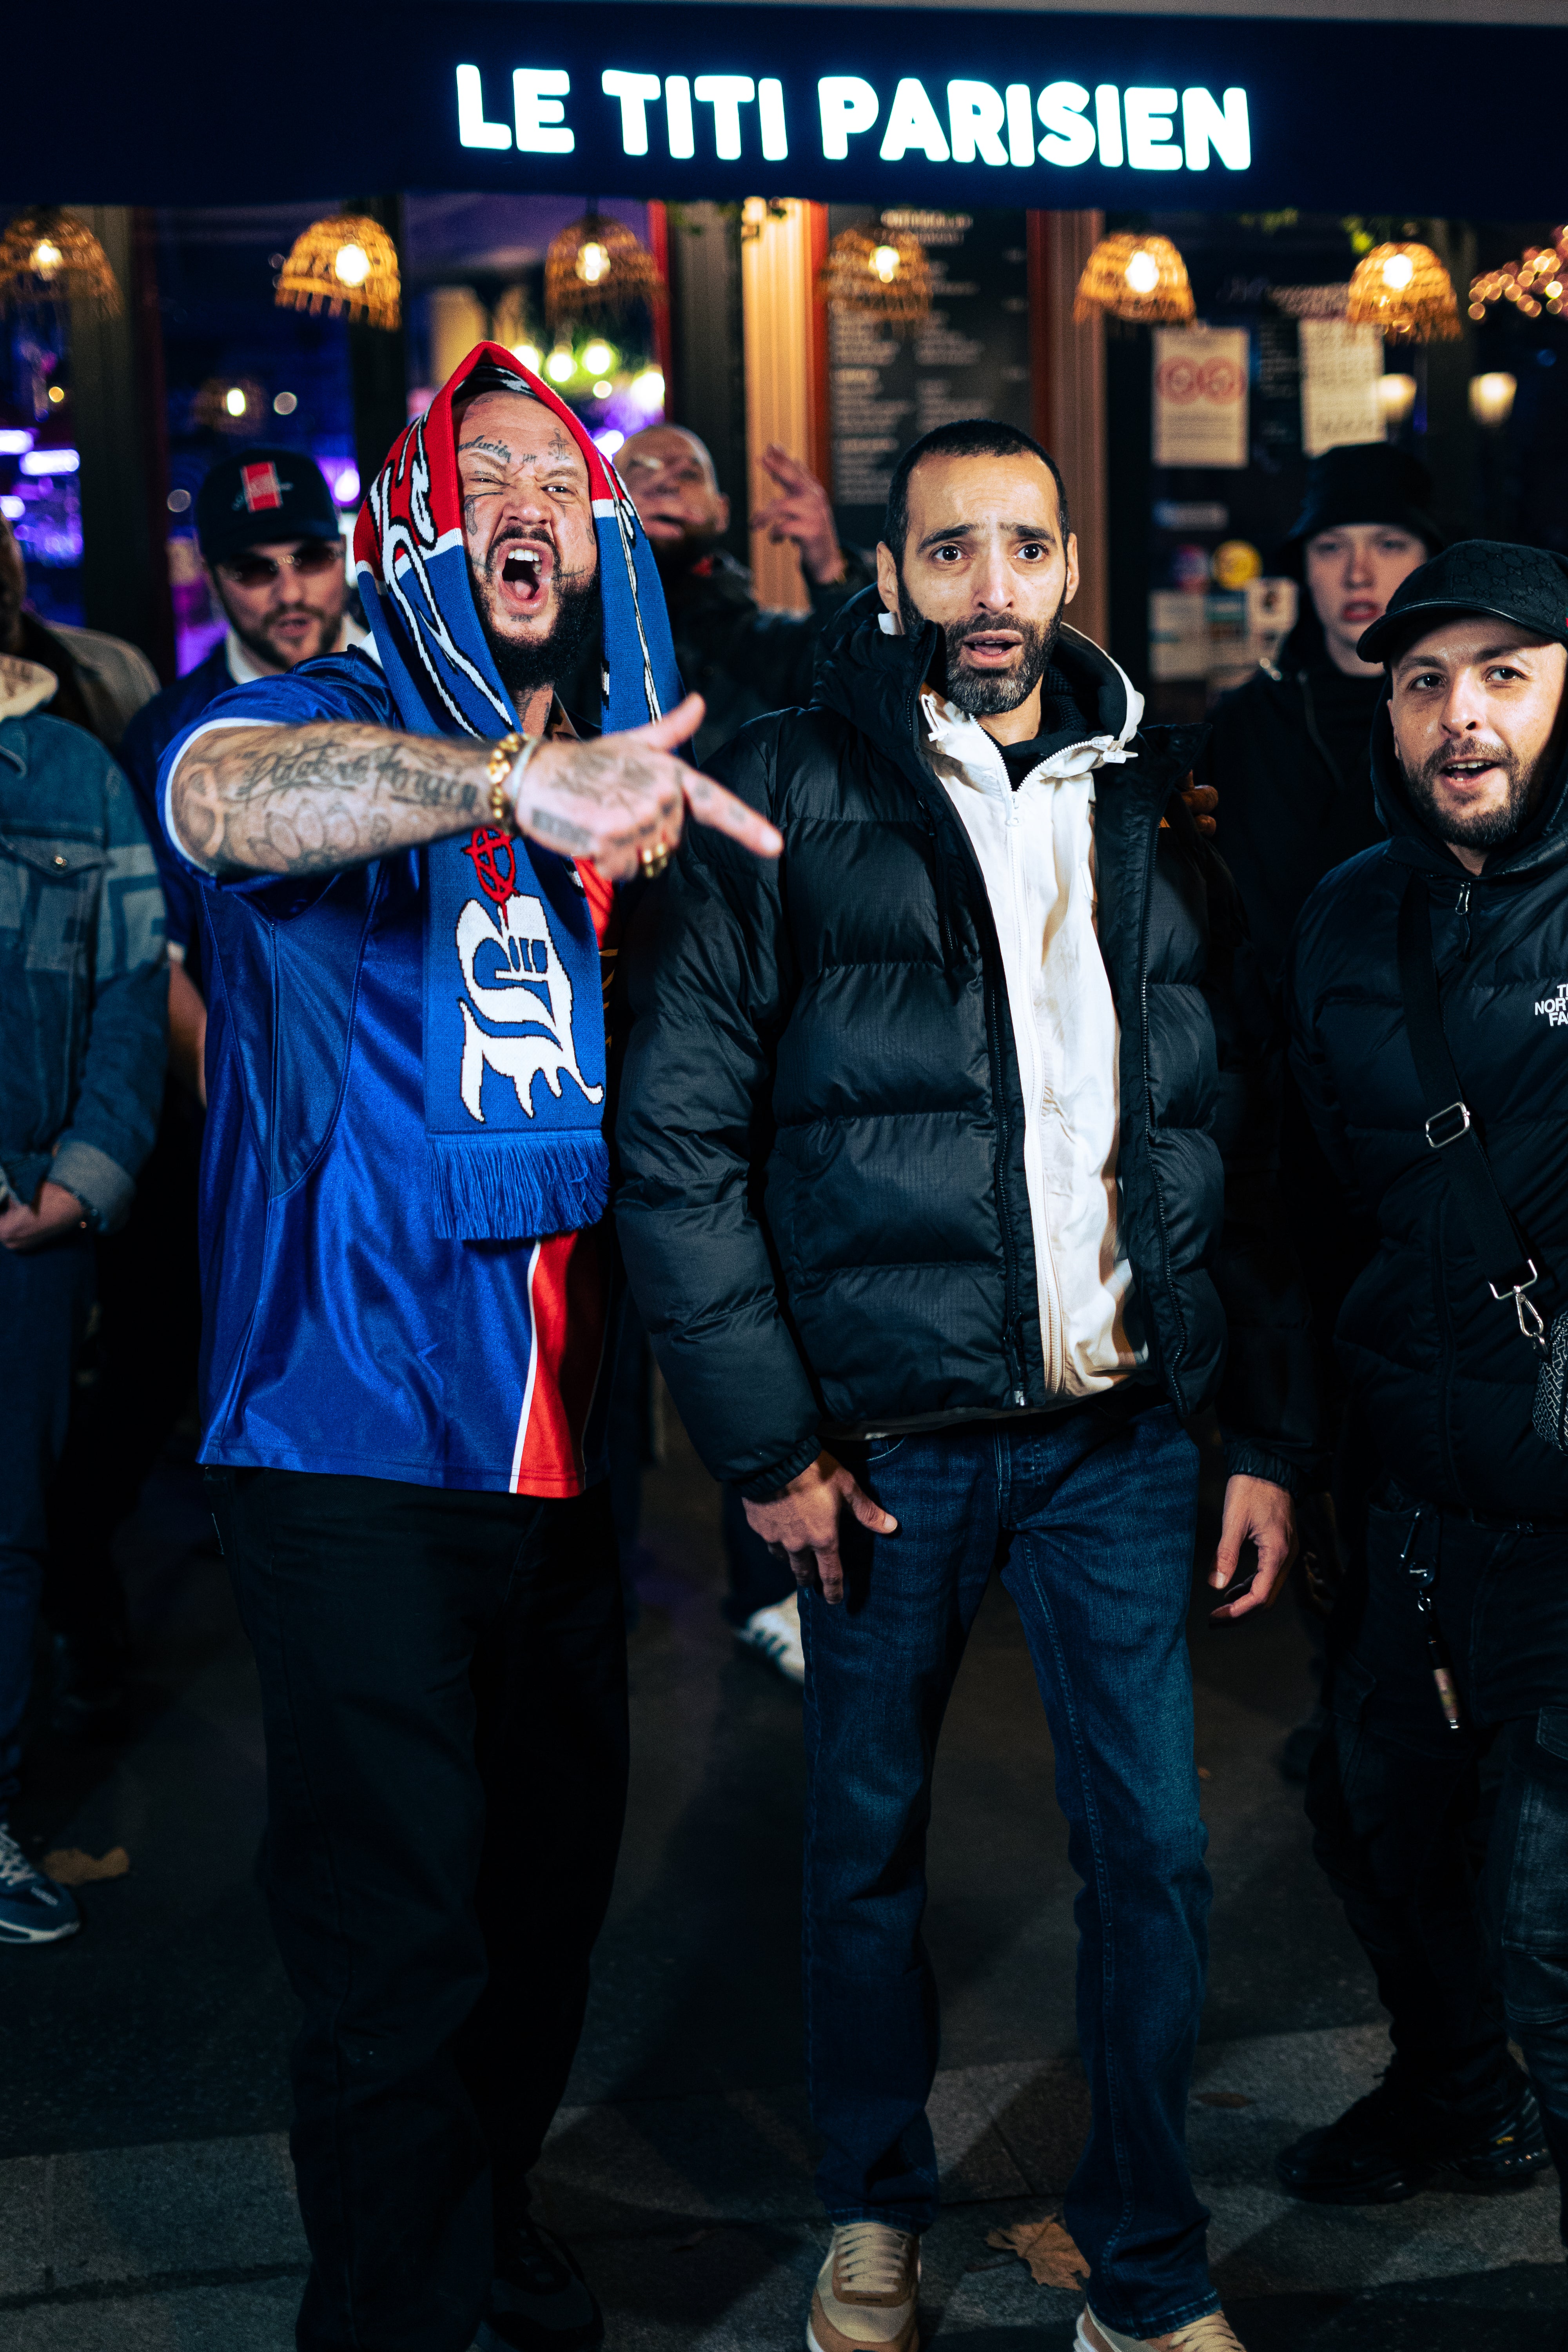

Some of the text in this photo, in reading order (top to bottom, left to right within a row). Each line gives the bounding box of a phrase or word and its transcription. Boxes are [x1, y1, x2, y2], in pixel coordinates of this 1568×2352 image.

[456, 65, 1250, 171] LE TITI PARISIEN
[1548, 1011, 1568, 1026] FA
